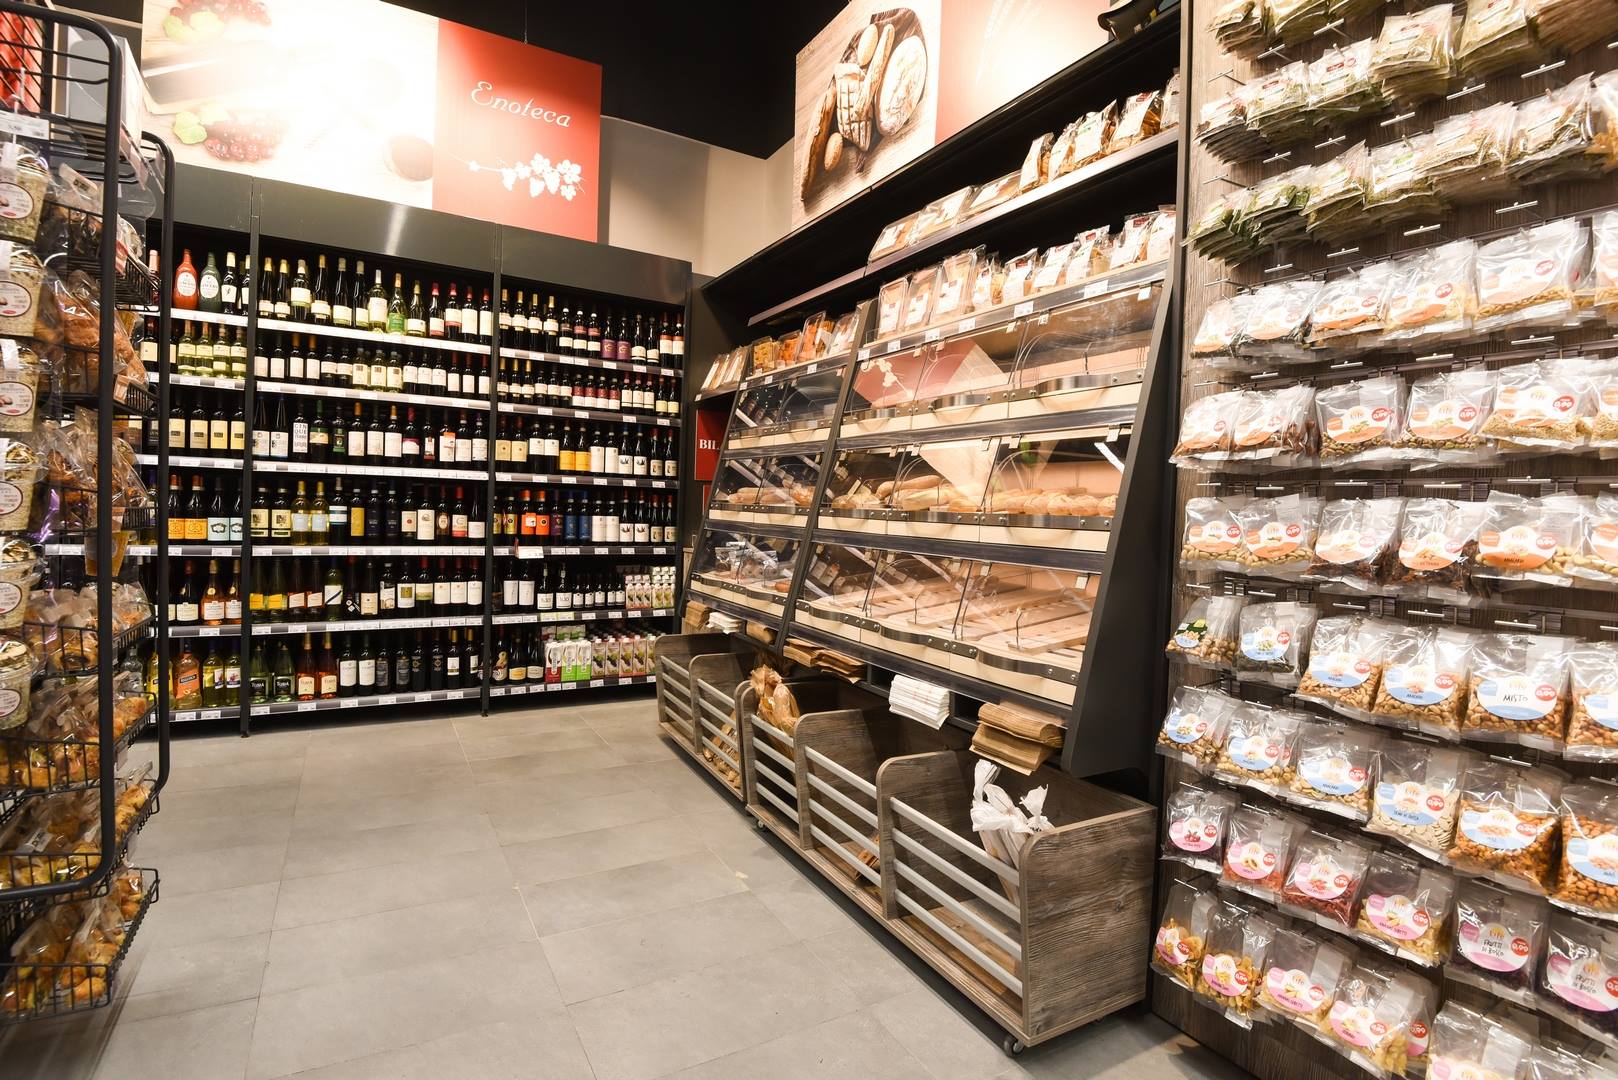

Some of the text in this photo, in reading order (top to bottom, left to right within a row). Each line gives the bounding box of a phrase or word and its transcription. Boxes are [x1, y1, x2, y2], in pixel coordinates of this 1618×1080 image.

[471, 80, 571, 128] Enoteca
[1503, 694, 1528, 702] MISTO
[1489, 930, 1504, 939] Life
[1483, 939, 1503, 949] FRUTTI
[1512, 942, 1528, 951] 0,99
